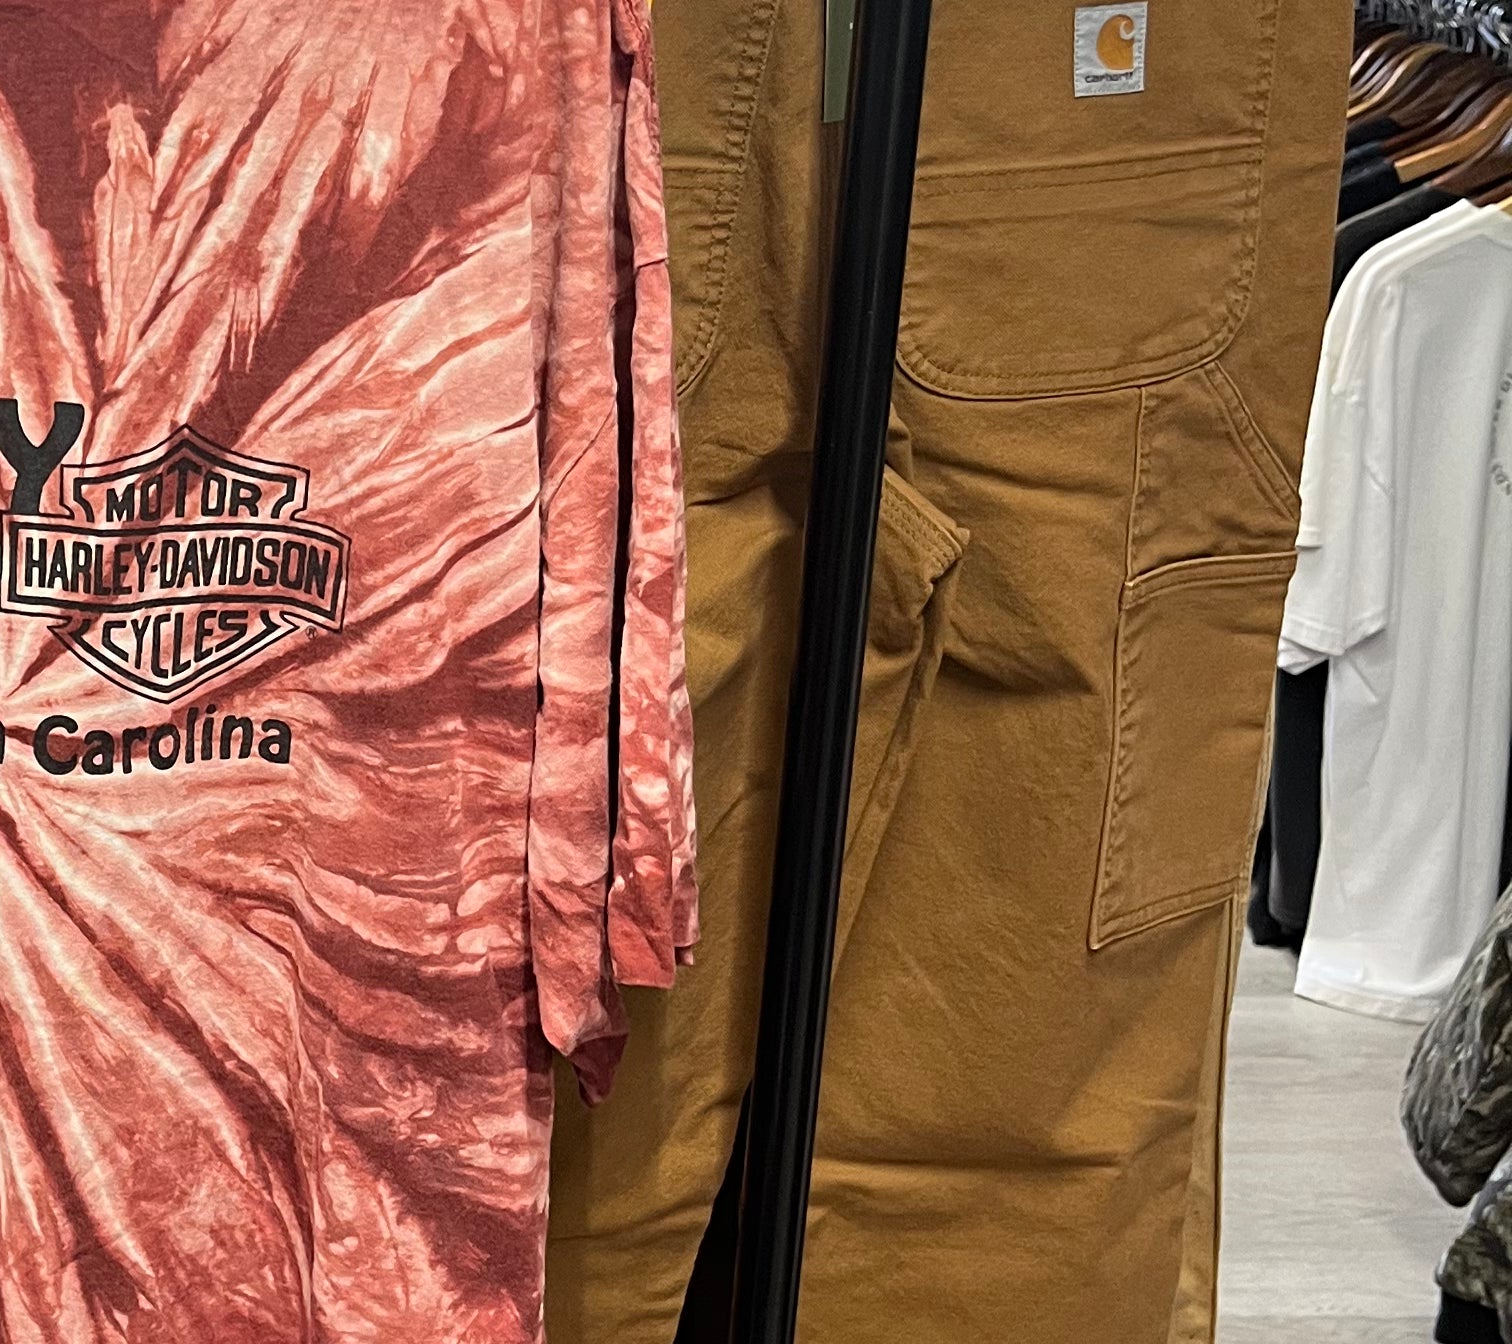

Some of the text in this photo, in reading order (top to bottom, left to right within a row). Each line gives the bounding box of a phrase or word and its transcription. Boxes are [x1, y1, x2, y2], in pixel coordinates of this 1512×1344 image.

[105, 455, 263, 523] MOTOR
[24, 536, 331, 600] HARLEY-DAVIDSON
[101, 610, 249, 679] CYCLES
[33, 702, 293, 776] Carolina
